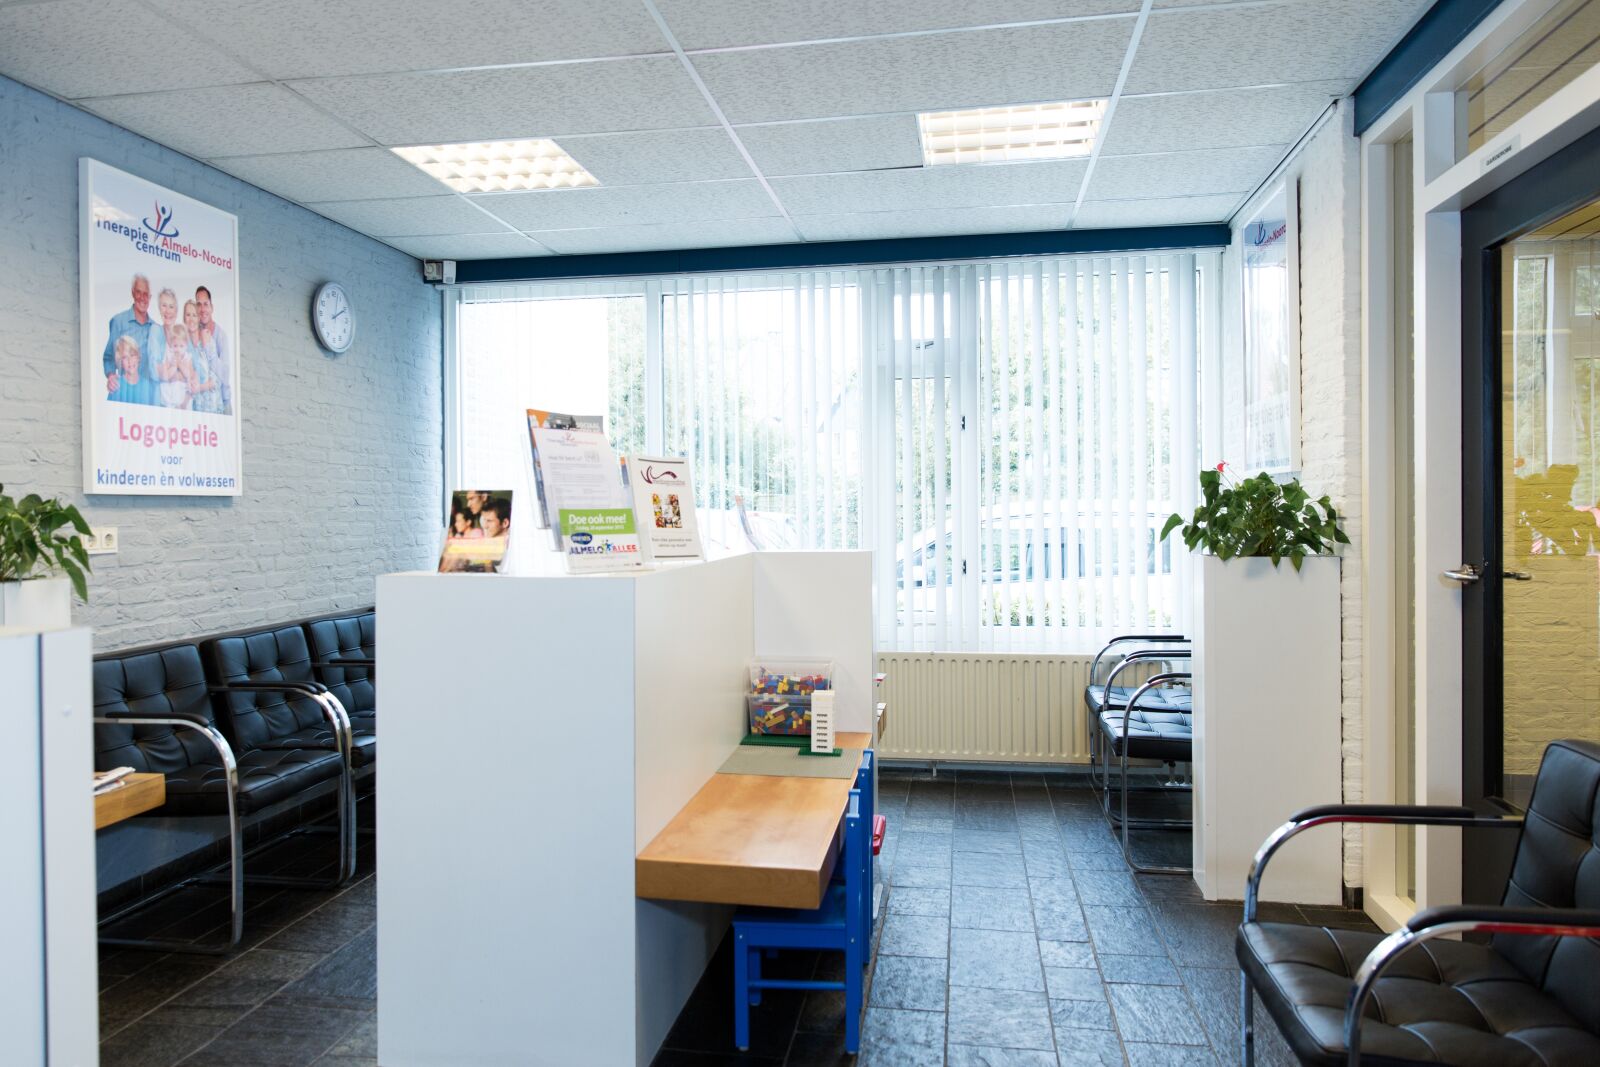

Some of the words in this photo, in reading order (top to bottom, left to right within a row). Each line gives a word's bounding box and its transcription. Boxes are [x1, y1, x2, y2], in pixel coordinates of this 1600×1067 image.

[95, 215, 149, 242] Therapie
[135, 240, 181, 263] centrum
[161, 236, 232, 270] Almelo-Noord
[118, 416, 218, 449] Logopedie
[160, 455, 184, 466] voor
[97, 468, 156, 486] kinderen
[160, 472, 175, 486] èn
[178, 473, 235, 488] volwassen
[568, 513, 587, 525] Doe
[588, 513, 606, 525] ook
[569, 545, 604, 555] ALMELO
[612, 544, 638, 553] ALLEE
